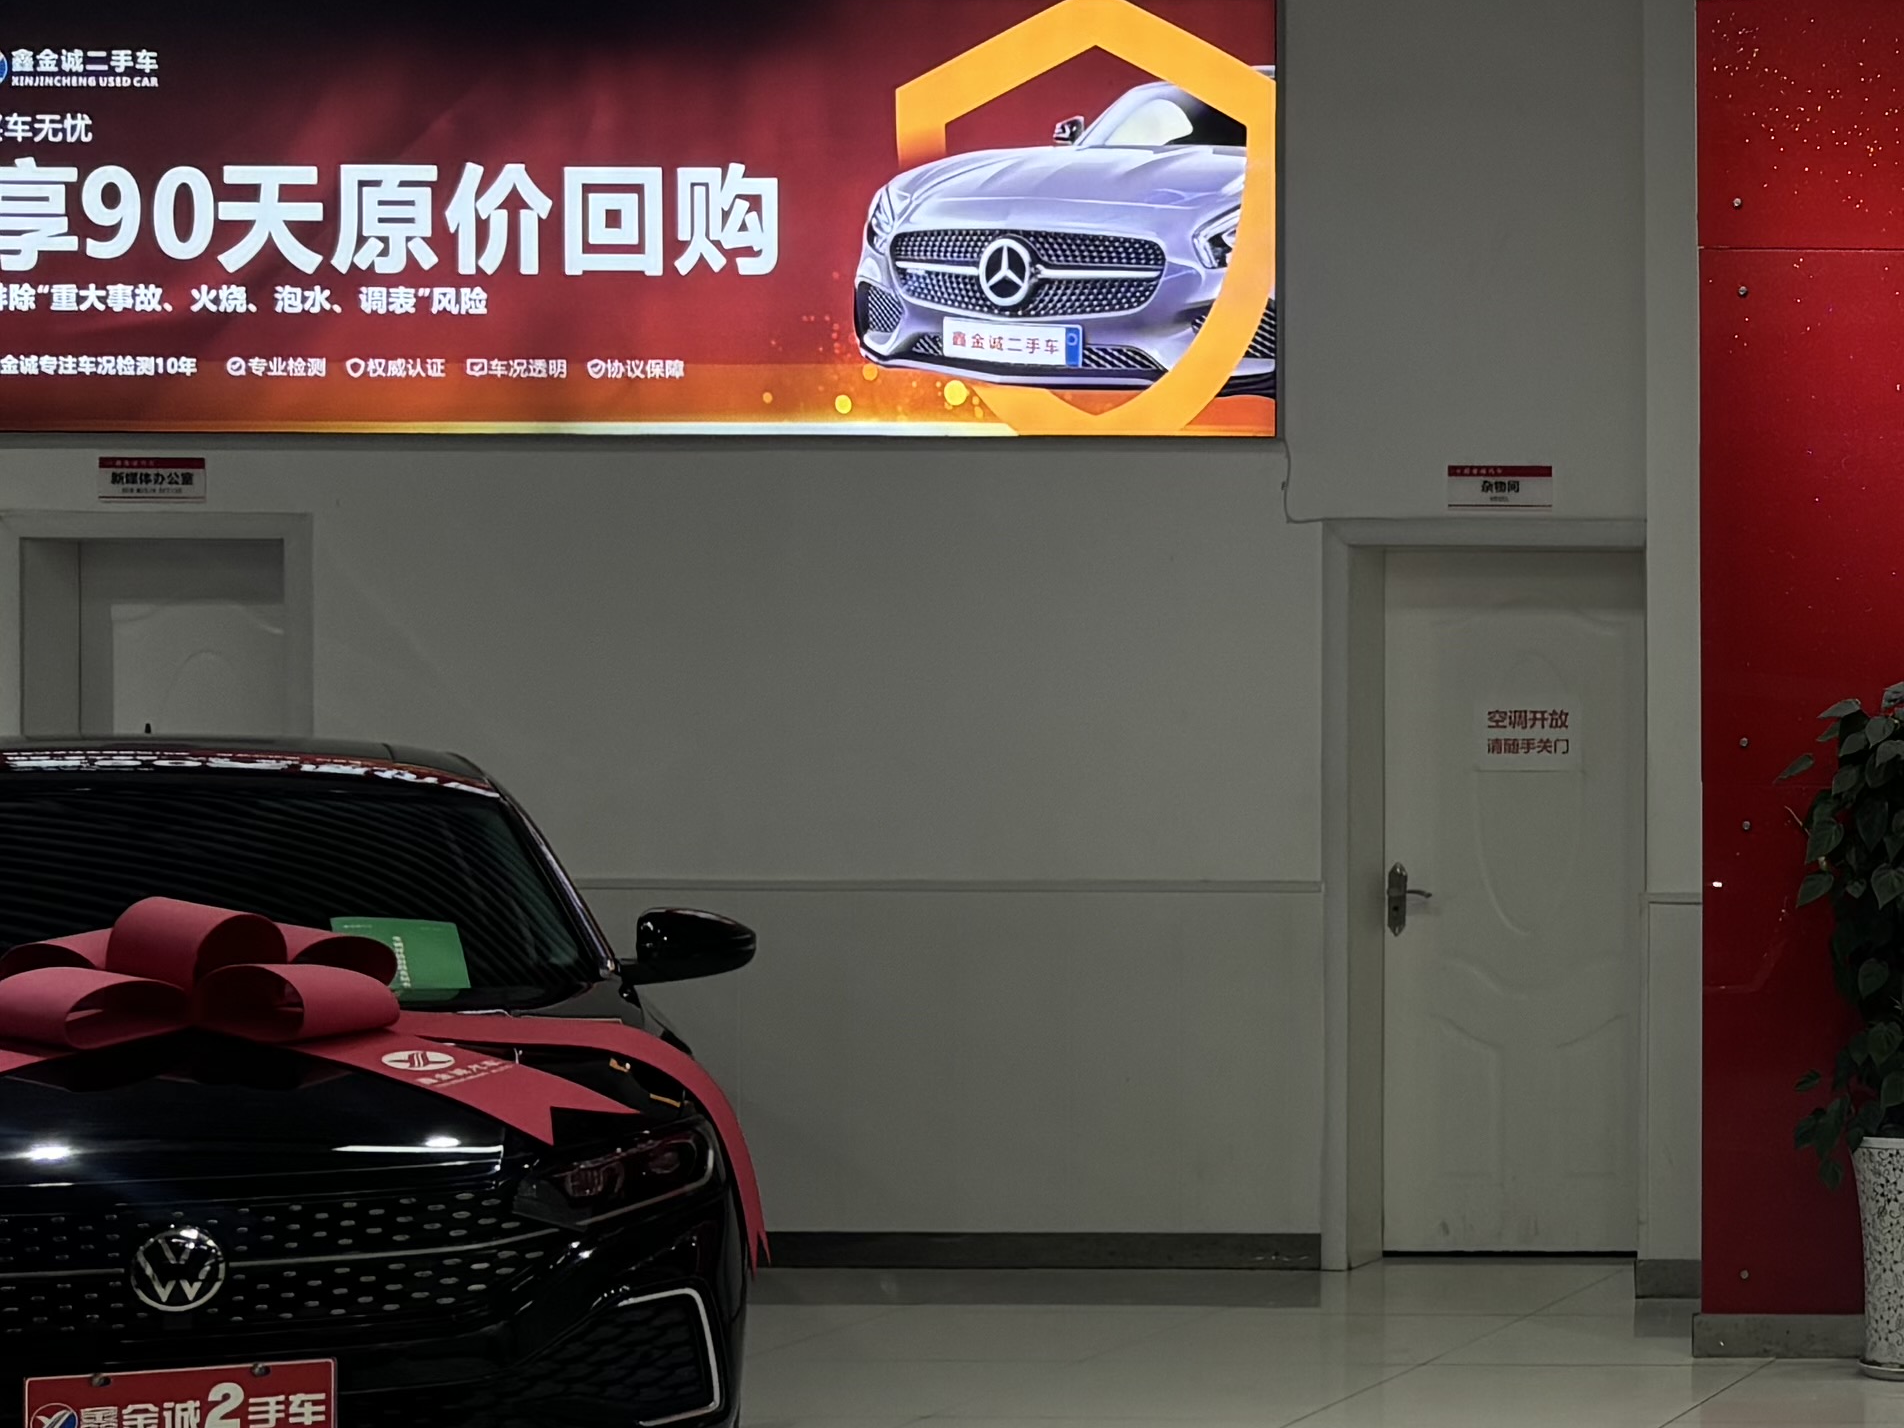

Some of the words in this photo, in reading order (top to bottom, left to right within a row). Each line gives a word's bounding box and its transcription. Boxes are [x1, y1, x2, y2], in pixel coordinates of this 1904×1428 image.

[11, 48, 159, 73] 鑫金诚二手车
[0, 113, 93, 143] 车无忧
[0, 156, 779, 277] 享90天原价回购
[952, 331, 1060, 355] 鑫金诚二手车
[248, 356, 326, 377] 专业检测
[367, 357, 446, 378] 权威认证
[488, 358, 567, 379] 车况透明
[606, 358, 685, 379] 协议保障
[1487, 709, 1569, 729] 空调开放
[1487, 738, 1570, 755] 请随手关门
